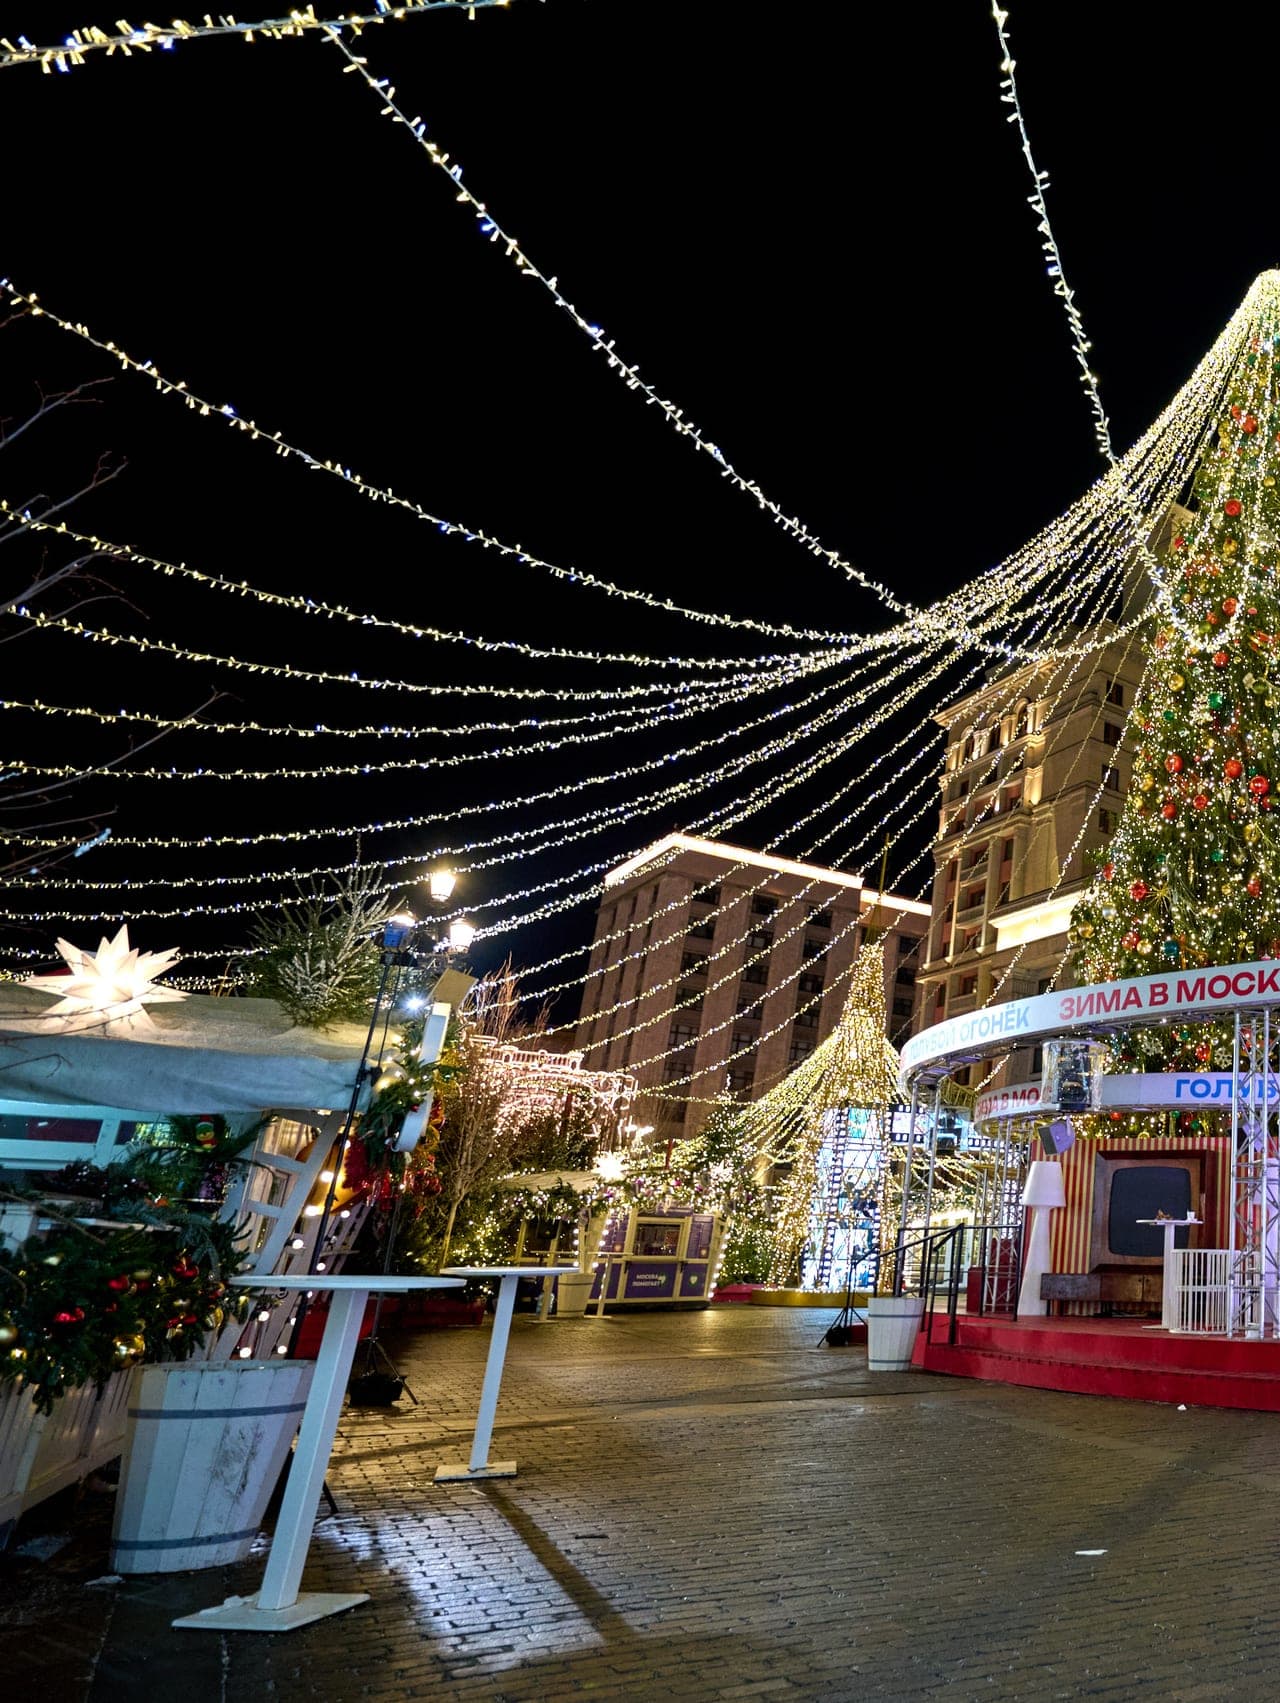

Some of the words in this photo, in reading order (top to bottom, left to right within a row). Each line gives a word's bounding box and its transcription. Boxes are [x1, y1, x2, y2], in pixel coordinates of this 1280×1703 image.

[1059, 987, 1143, 1021] ЗИМА
[1149, 982, 1169, 1006] В
[960, 1004, 1030, 1042] ОГОНЁК
